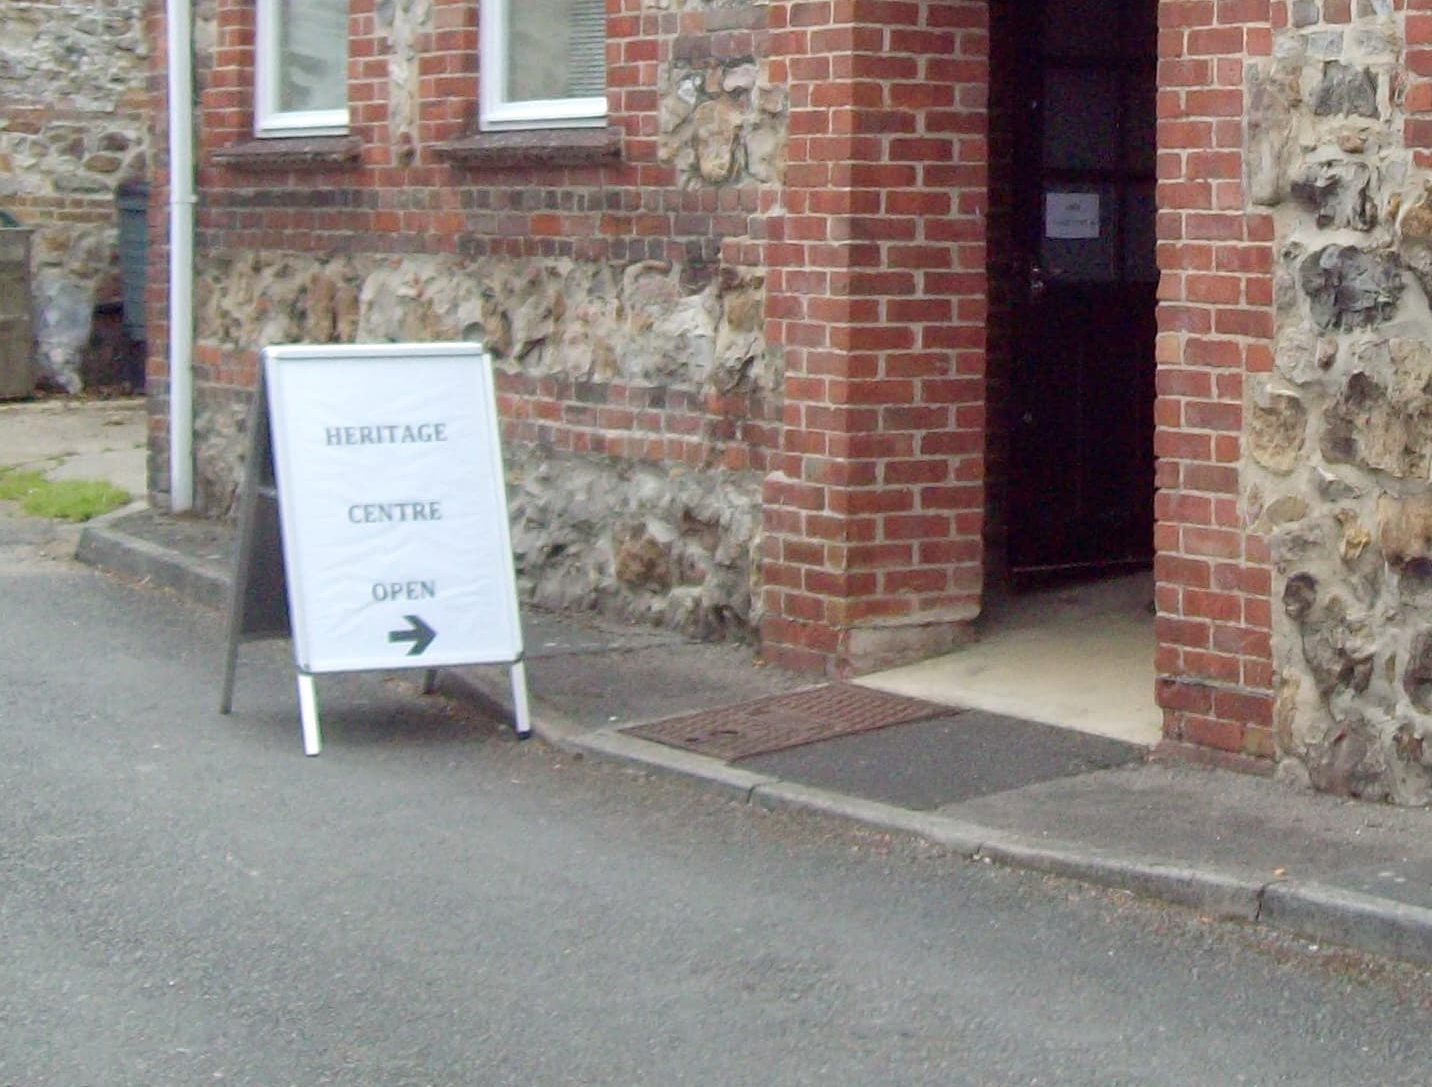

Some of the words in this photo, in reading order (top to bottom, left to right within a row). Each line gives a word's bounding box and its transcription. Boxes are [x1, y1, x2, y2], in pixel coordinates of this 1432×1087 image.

[325, 423, 448, 447] HERITAGE
[348, 502, 442, 524] CENTRE
[372, 580, 436, 602] OPEN
